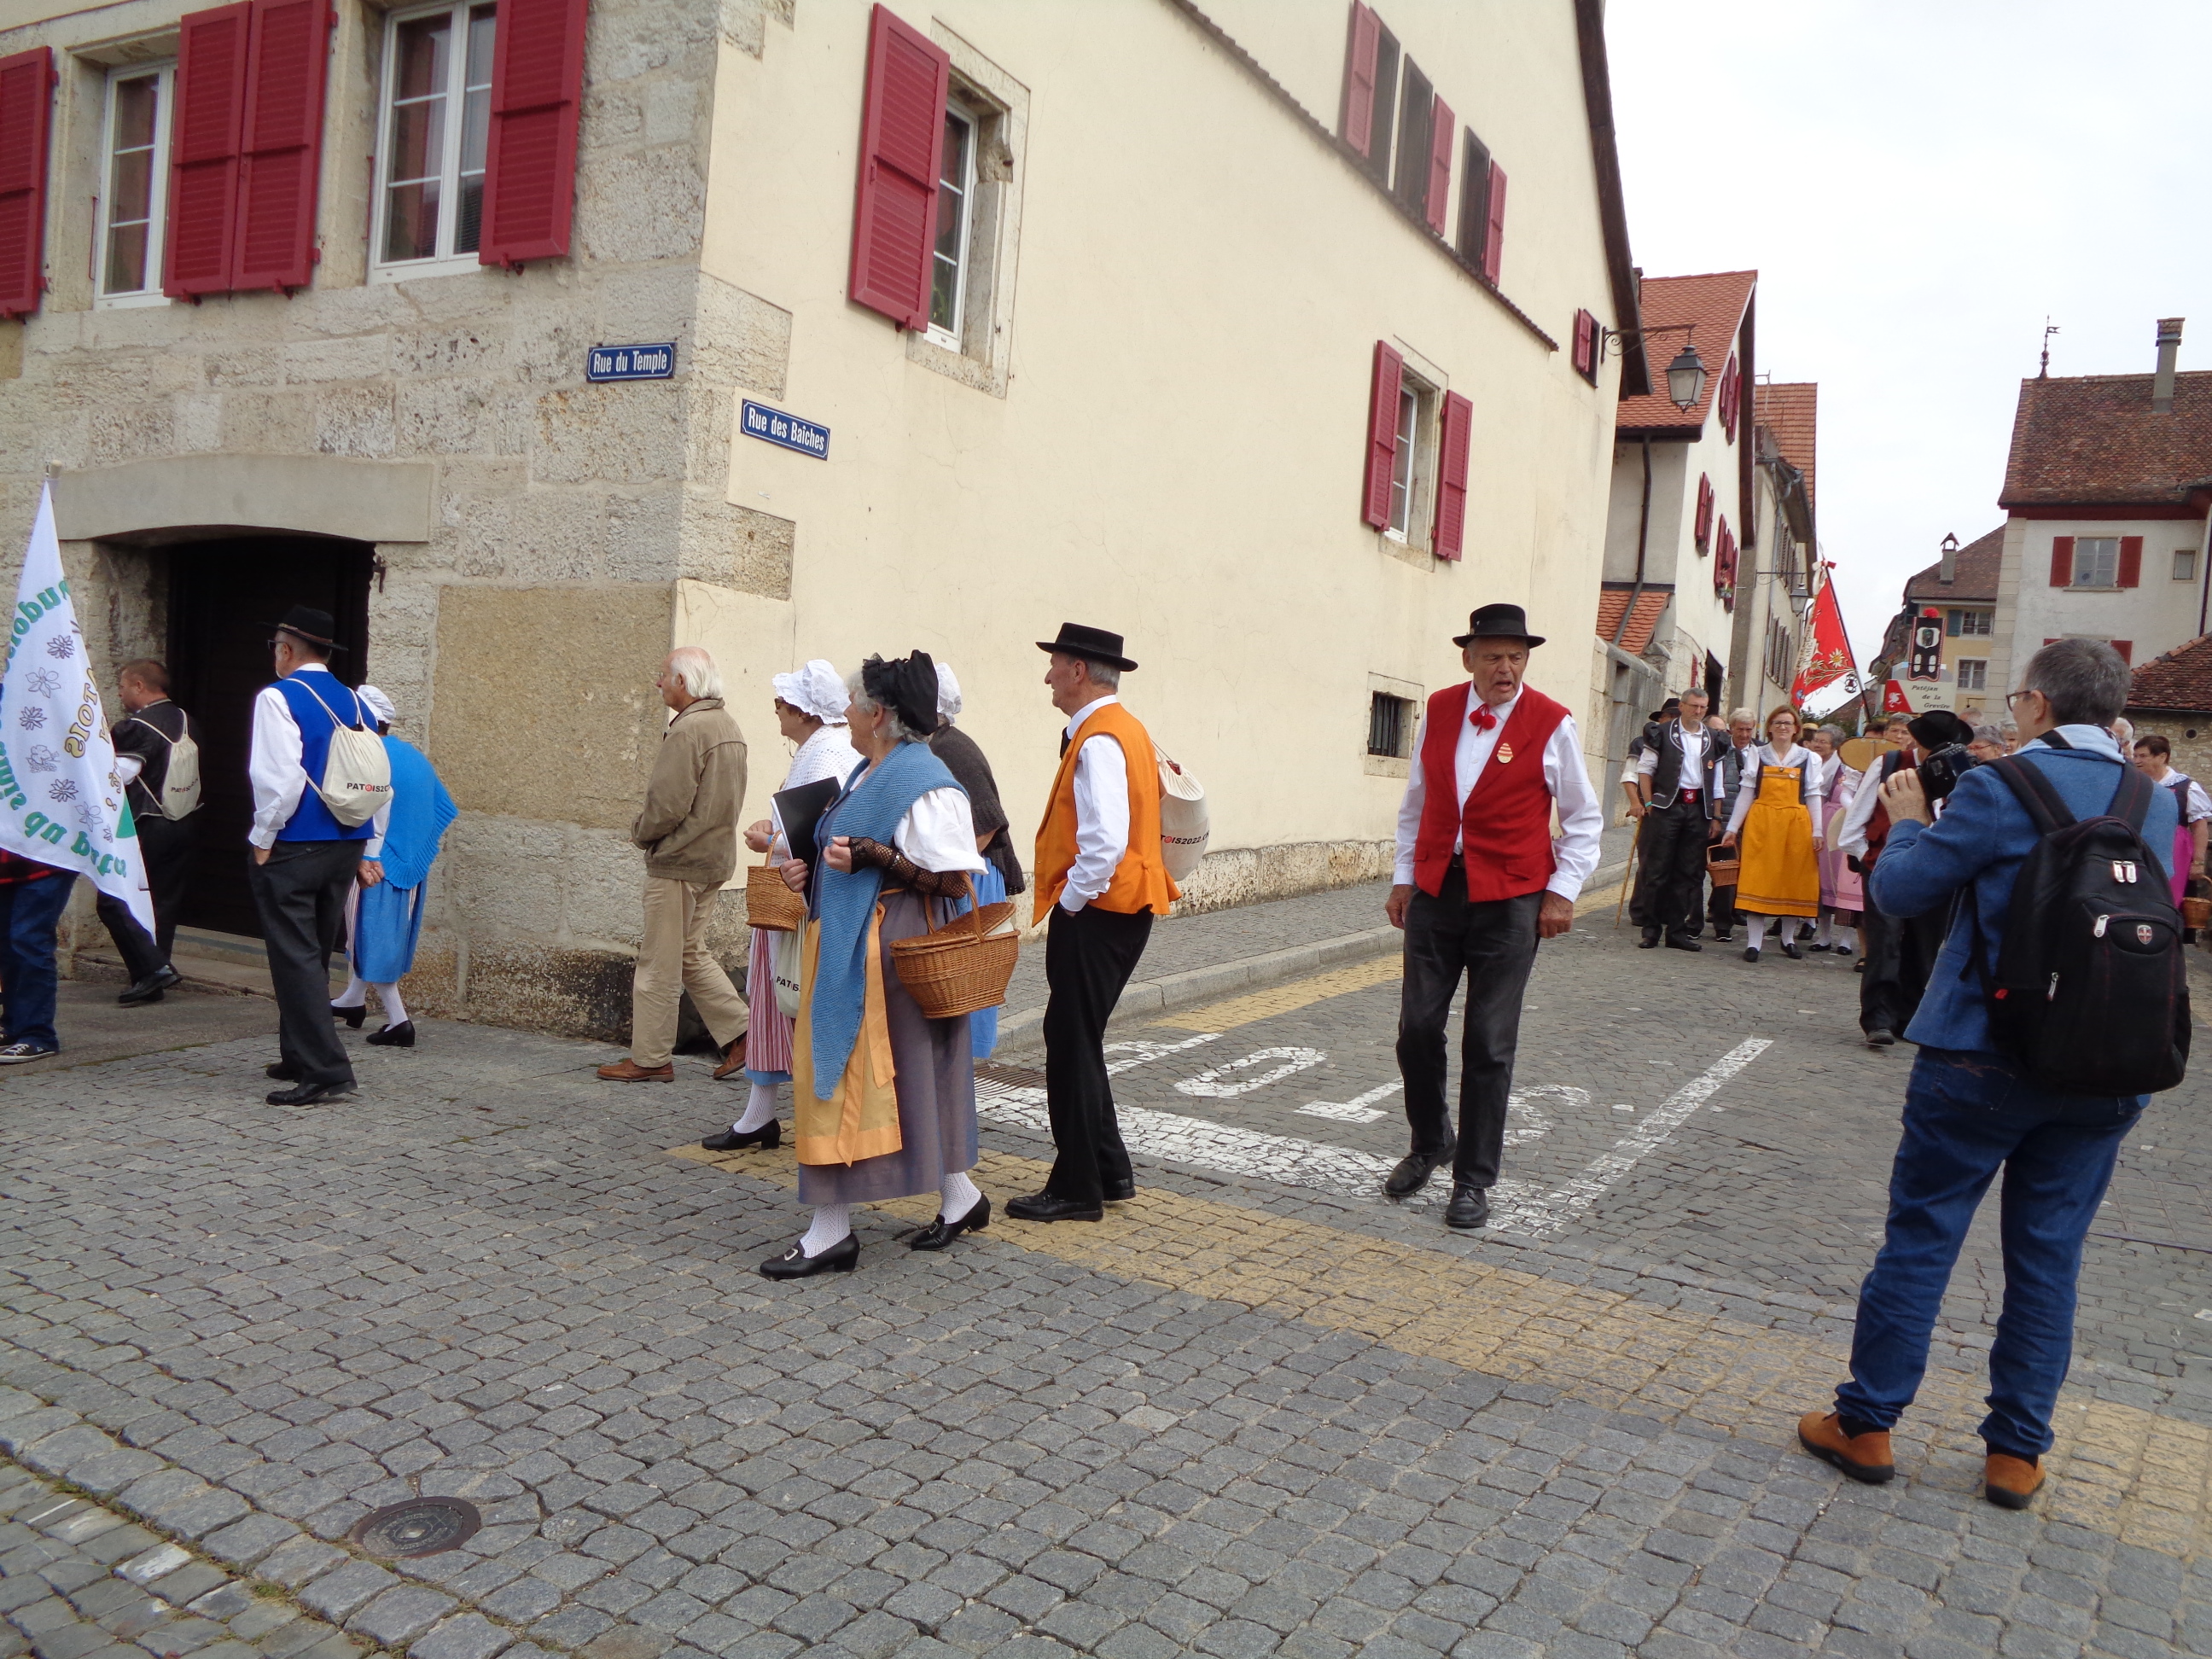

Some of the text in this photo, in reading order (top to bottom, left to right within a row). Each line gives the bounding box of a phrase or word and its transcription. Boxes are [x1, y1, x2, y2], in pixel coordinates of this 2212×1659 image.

[593, 349, 667, 374] Rue du Temple
[748, 406, 824, 451] Rue des Baîches
